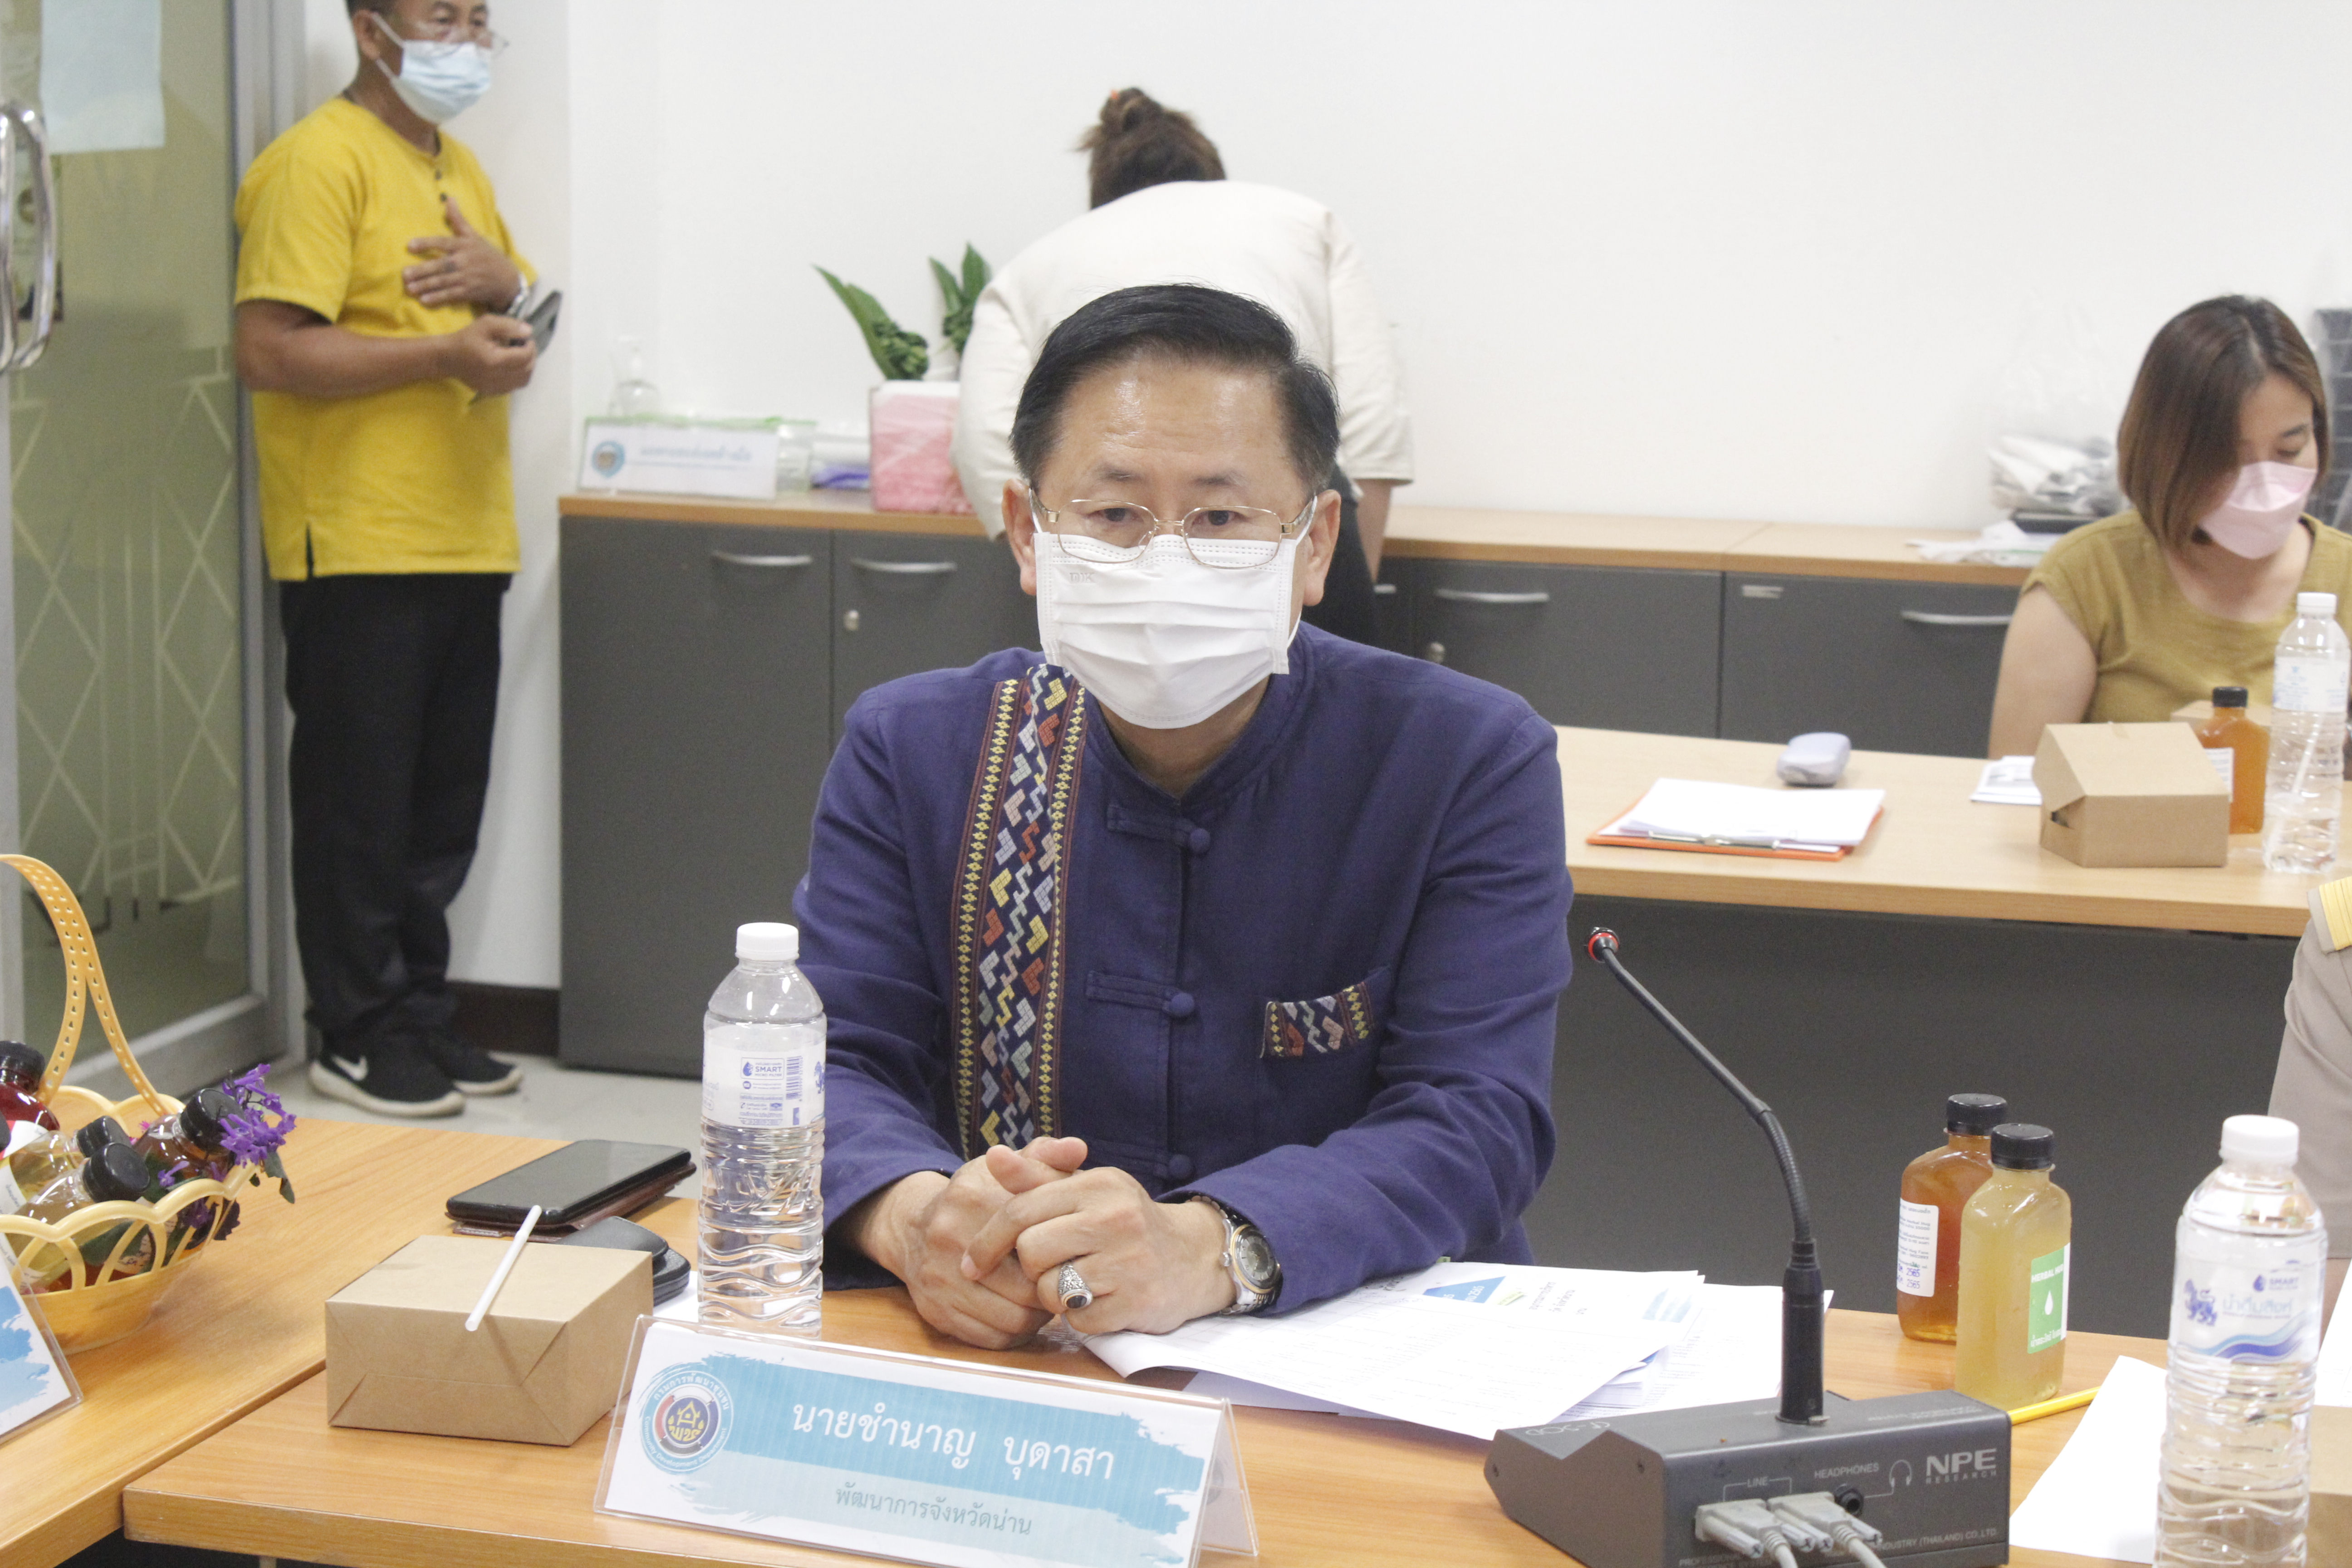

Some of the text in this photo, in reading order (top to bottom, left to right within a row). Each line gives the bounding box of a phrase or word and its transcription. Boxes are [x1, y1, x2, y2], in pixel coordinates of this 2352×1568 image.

[1906, 1279, 1920, 1289] 2565
[2031, 1269, 2054, 1283] HERBAL
[653, 1372, 730, 1410] กรมการพัฒนาชุมชน
[645, 1416, 727, 1468] Community Development Department
[793, 1402, 1115, 1480] นายชำนาญ บุดาสา
[1815, 1462, 1880, 1479] HEADPHONES
[1926, 1448, 1996, 1477] NPE
[1747, 1476, 1769, 1488] LINE
[1926, 1471, 1997, 1485] RESEARCH
[836, 1481, 1032, 1535] พัฒนาการจังหวัดน่าน
